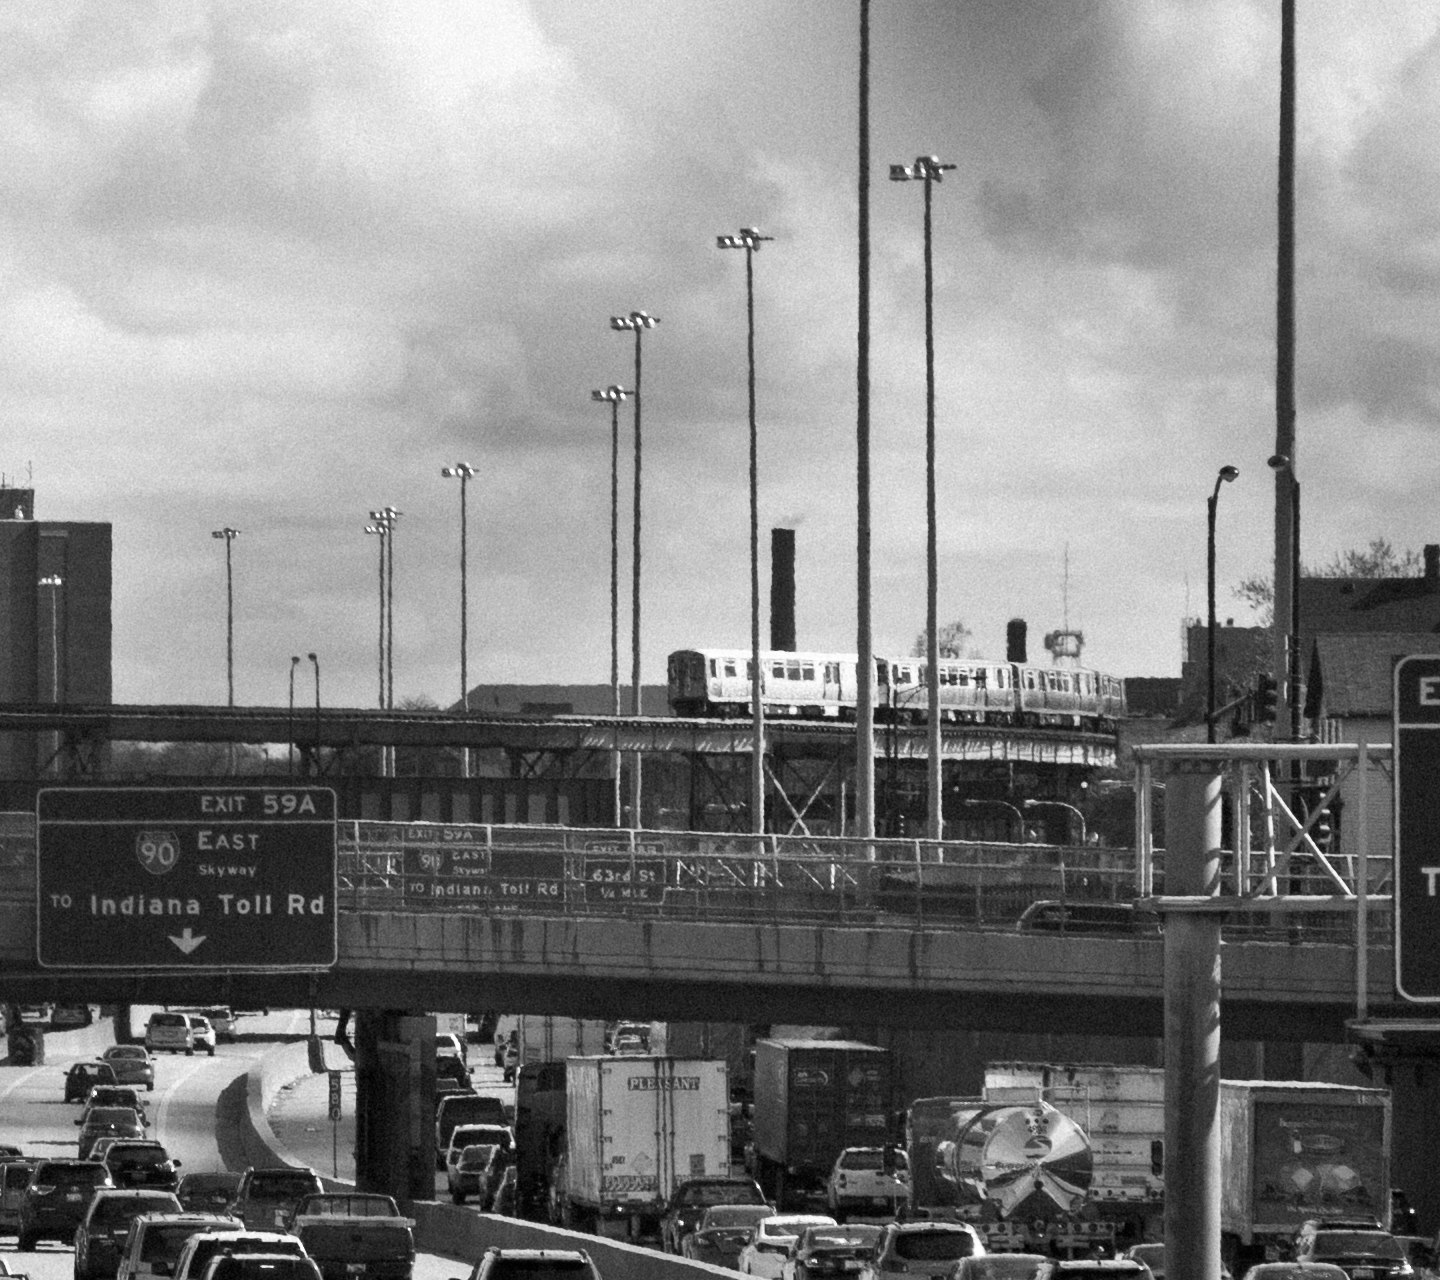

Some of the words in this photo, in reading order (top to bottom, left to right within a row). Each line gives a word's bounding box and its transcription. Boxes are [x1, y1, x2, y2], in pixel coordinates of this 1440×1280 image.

[201, 796, 246, 813] EXIT
[263, 794, 316, 814] 59A
[198, 831, 259, 851] EAST
[140, 843, 175, 866] 90
[198, 864, 257, 878] Skyway
[50, 894, 72, 908] TO
[91, 894, 200, 916] Indiana
[218, 894, 272, 915] Toll
[287, 893, 325, 915] Rd
[628, 1077, 700, 1091] PLEASANT
